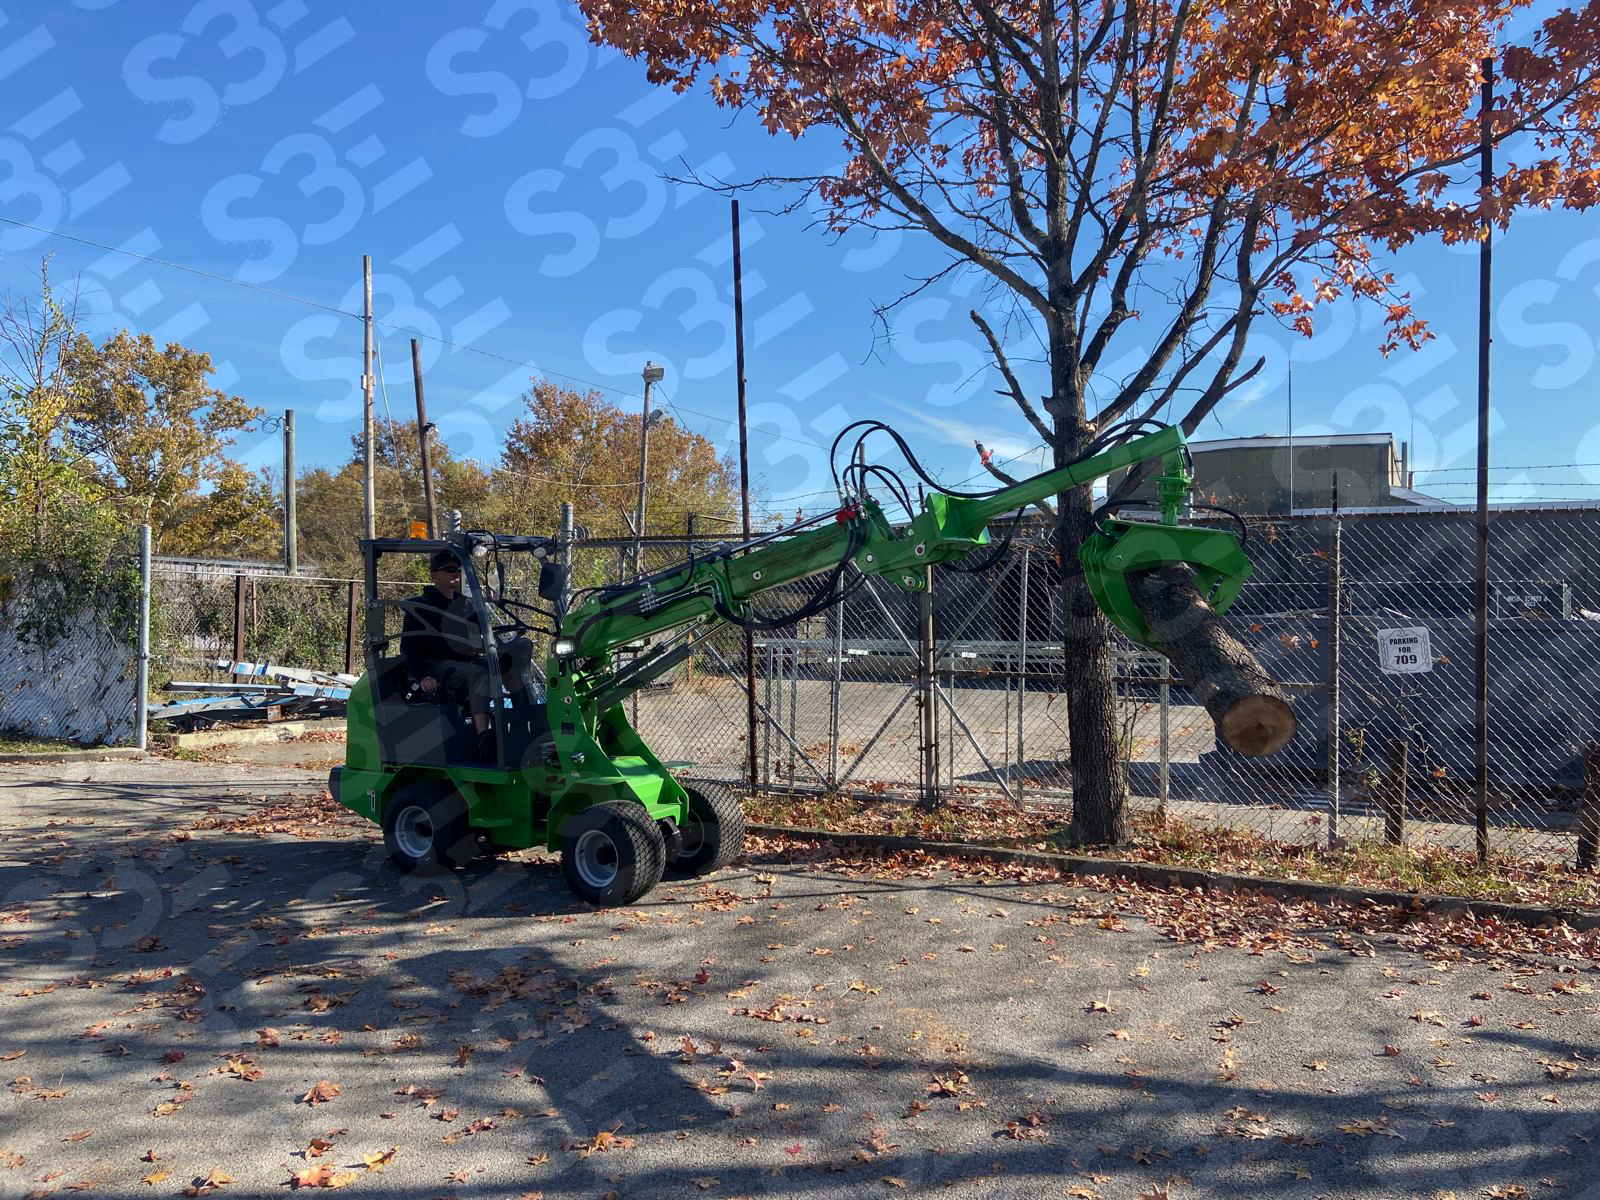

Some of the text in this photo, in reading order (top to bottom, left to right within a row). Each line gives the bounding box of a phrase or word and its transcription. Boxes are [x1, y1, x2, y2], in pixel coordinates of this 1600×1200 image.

[1389, 637, 1419, 645] PARKING
[1398, 646, 1412, 654] FOR
[1394, 654, 1418, 665] 709
